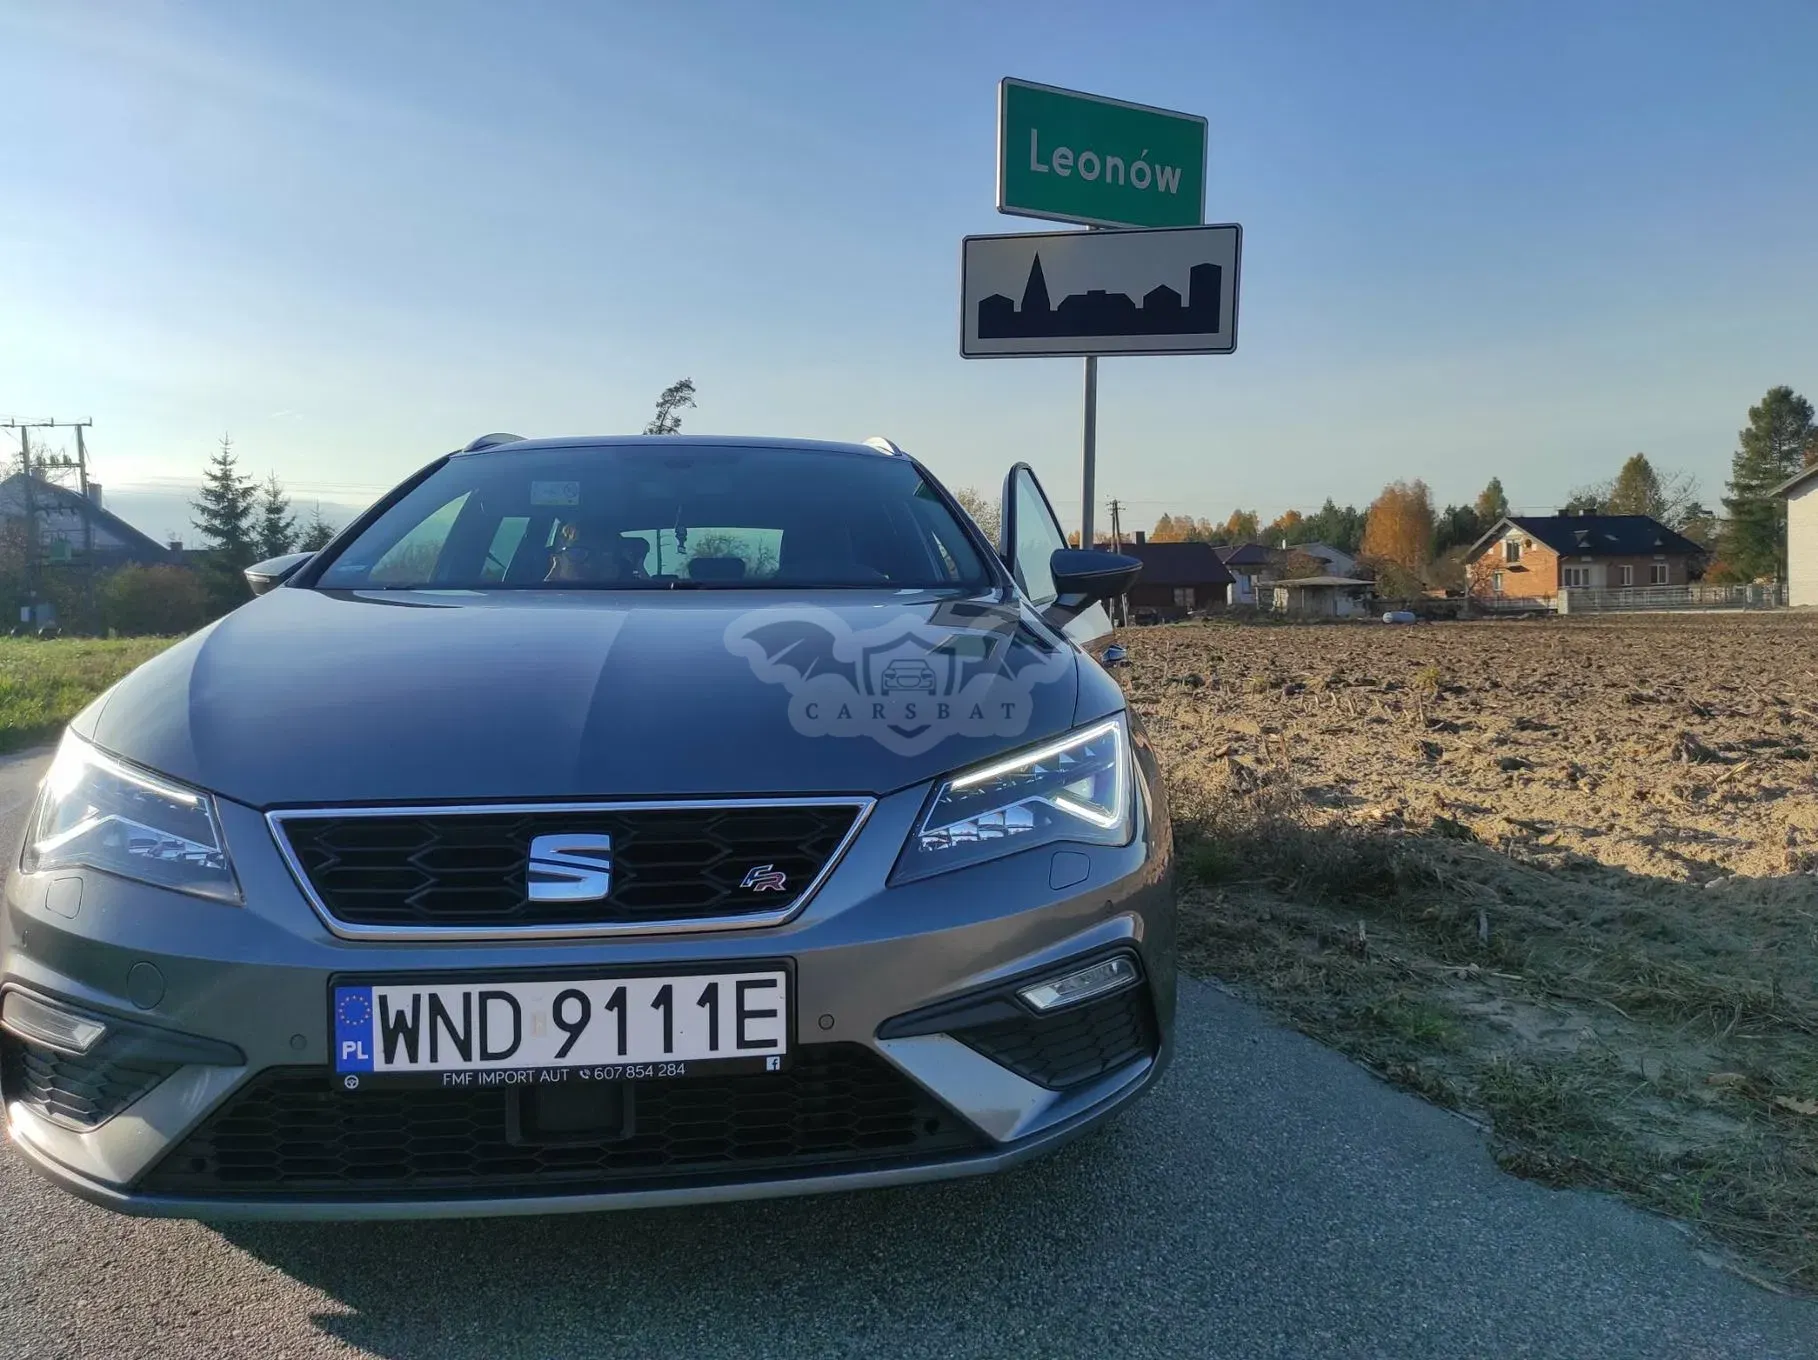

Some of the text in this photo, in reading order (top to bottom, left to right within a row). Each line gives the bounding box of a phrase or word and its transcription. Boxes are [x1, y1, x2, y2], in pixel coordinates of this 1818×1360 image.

[1030, 127, 1182, 194] Leonów
[740, 864, 786, 892] FR
[378, 978, 778, 1065] WND 9111E
[342, 1040, 369, 1060] PL
[442, 1063, 686, 1086] FMF IMPORT AUT 607 854 284
